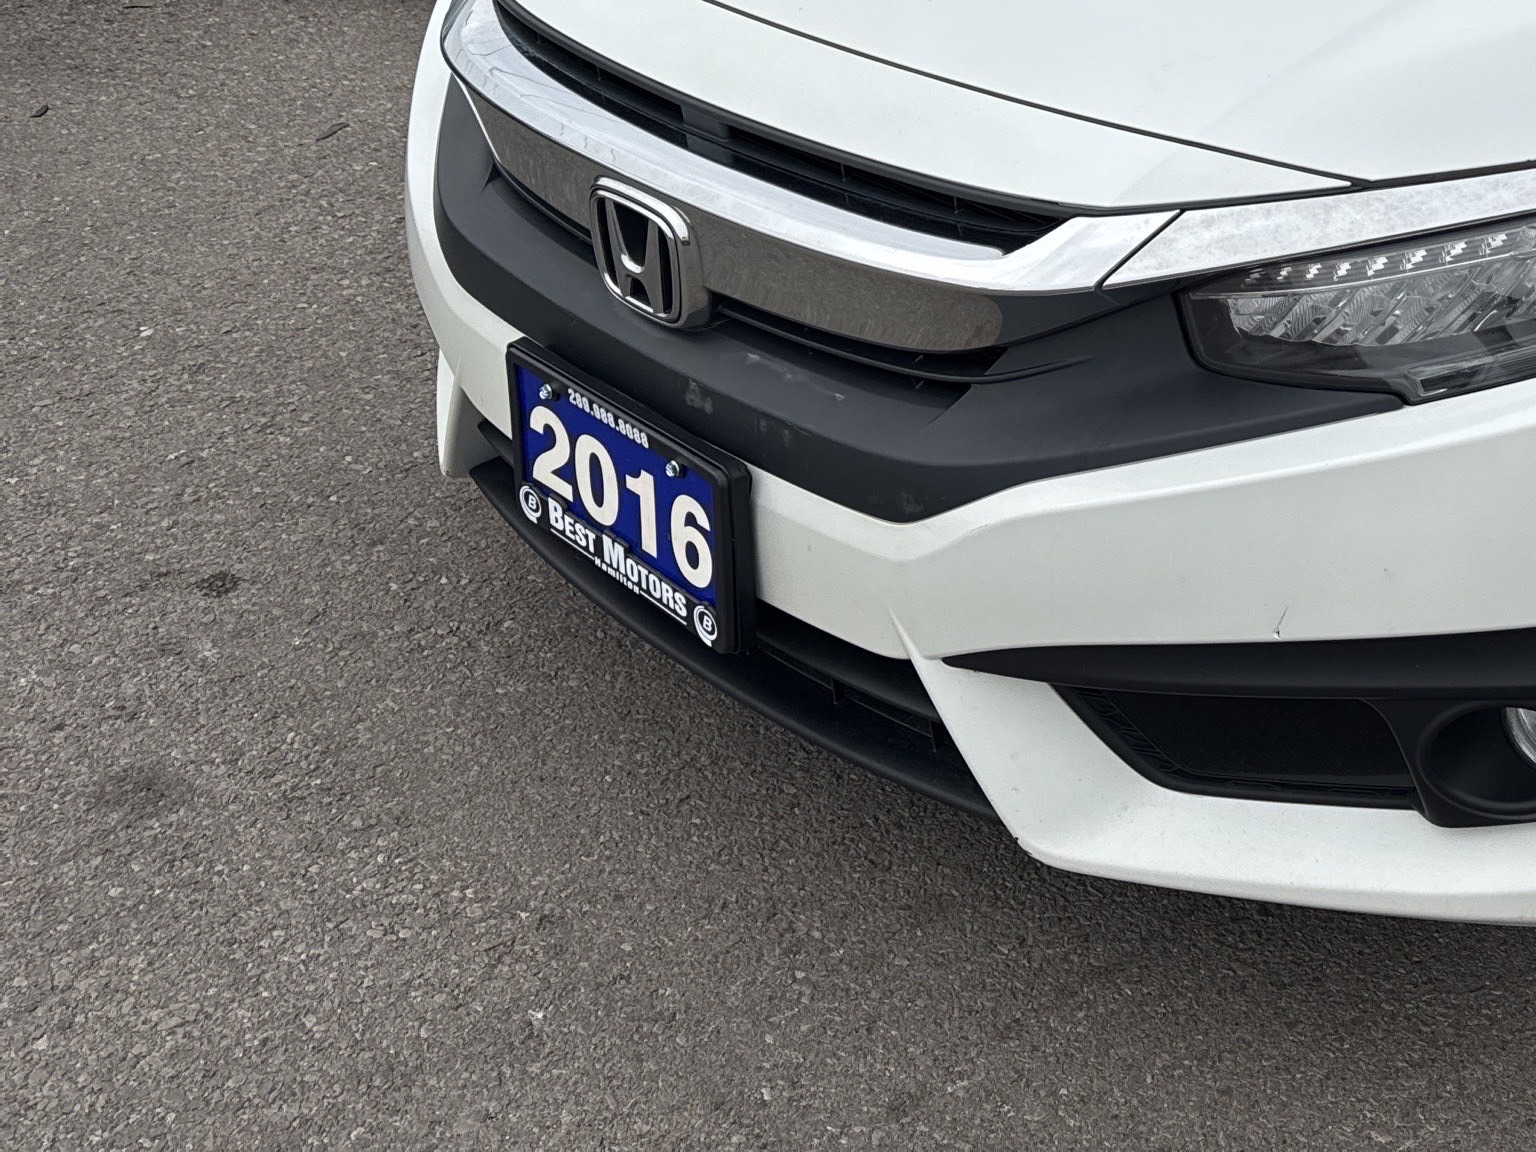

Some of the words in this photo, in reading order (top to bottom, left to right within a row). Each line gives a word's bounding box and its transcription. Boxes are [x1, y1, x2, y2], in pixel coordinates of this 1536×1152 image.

[567, 388, 649, 449] 289.988.8088
[529, 405, 713, 589] 2016
[594, 556, 640, 595] Hamilton
